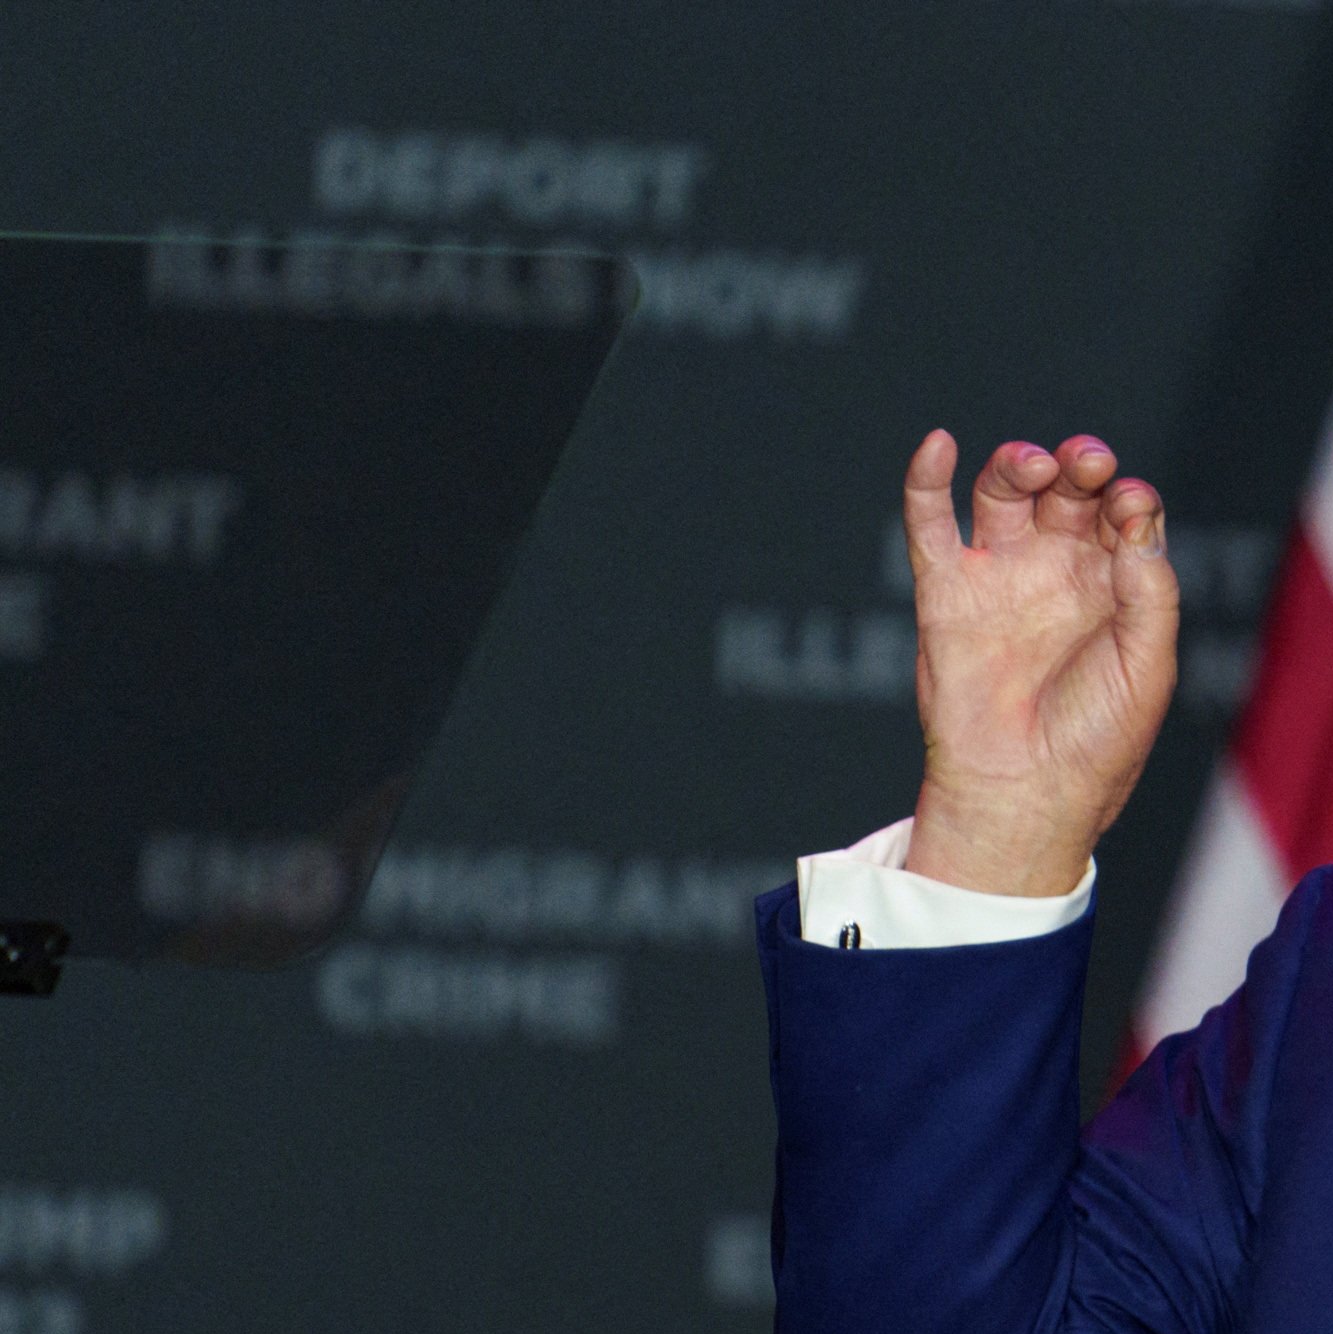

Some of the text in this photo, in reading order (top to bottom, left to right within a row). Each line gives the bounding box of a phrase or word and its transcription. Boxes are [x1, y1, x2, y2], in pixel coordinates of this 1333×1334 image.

[316, 130, 704, 224] DEPORT
[148, 224, 862, 340] ILLEGALS NOW
[140, 836, 342, 916] END
[318, 948, 620, 1044] CRIME
